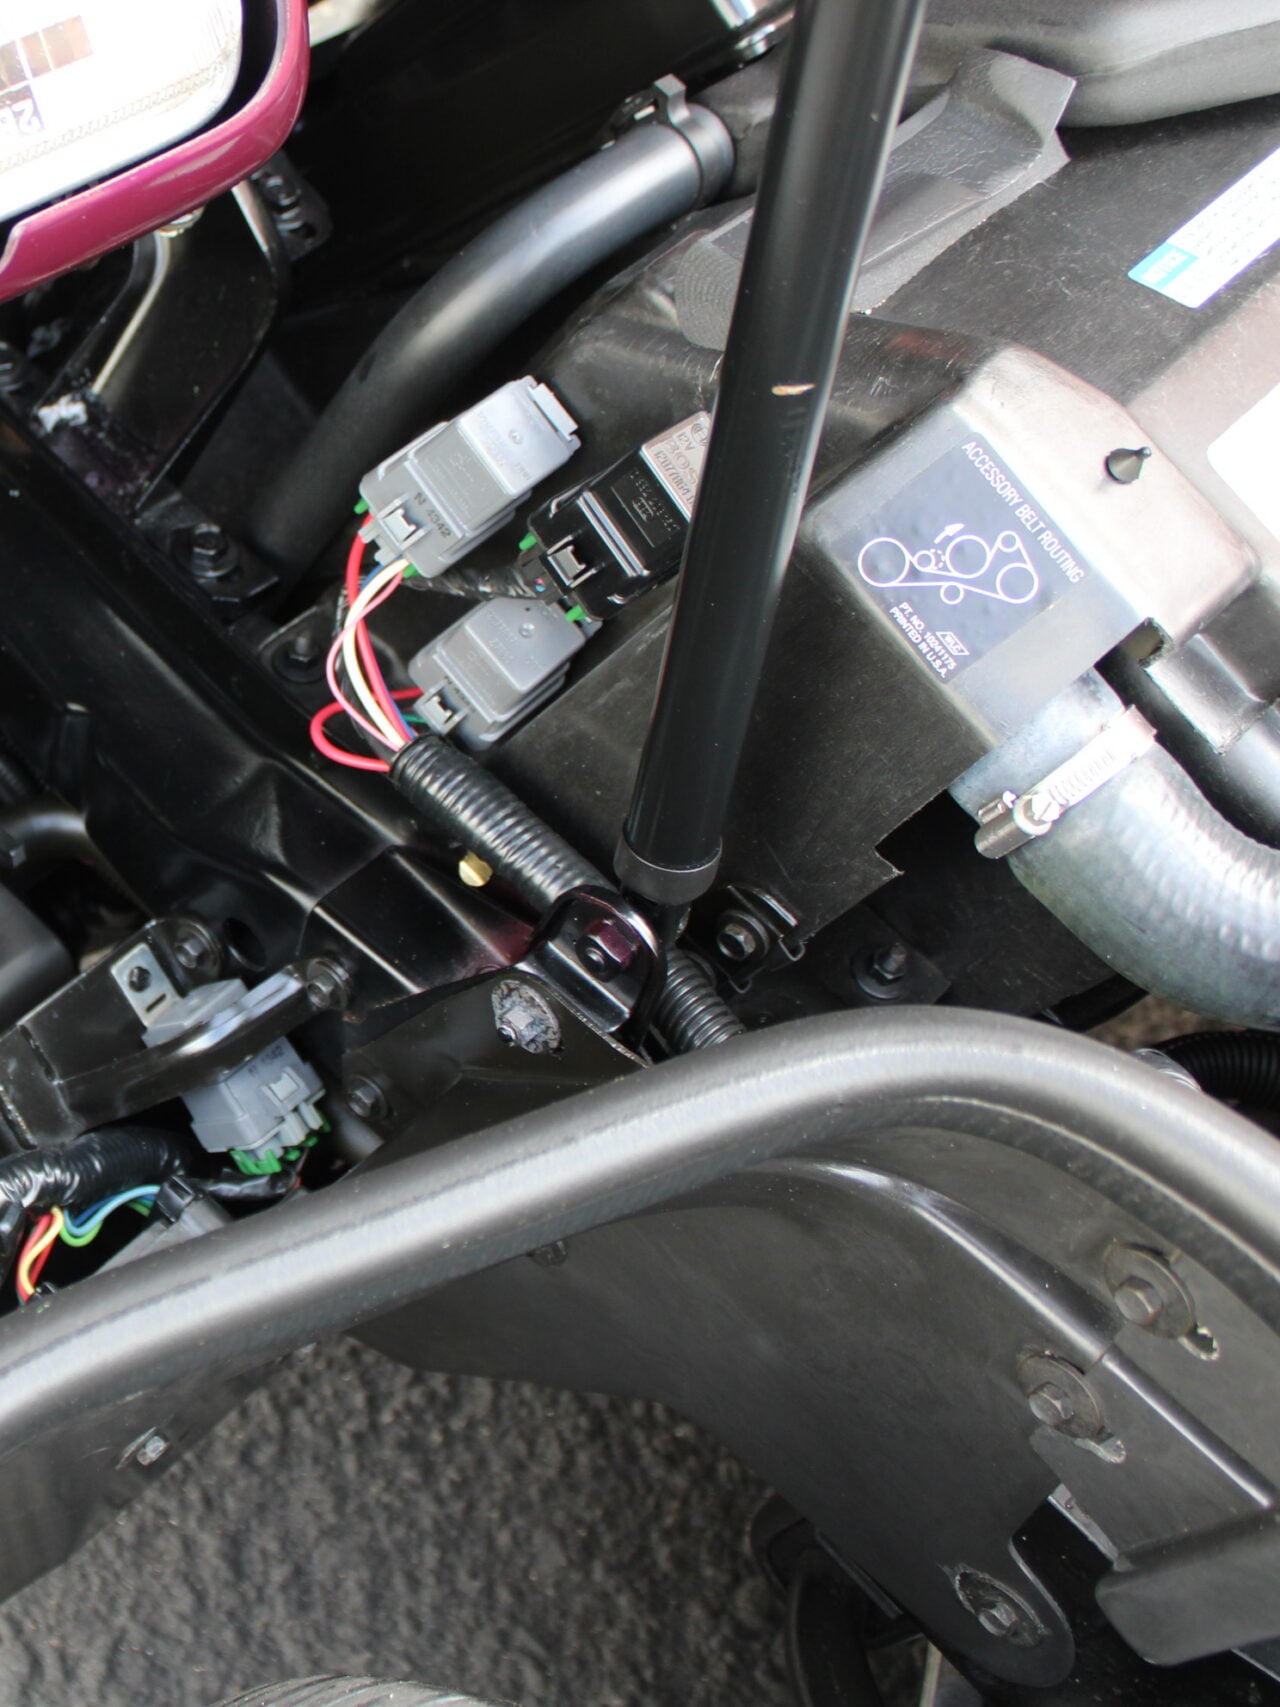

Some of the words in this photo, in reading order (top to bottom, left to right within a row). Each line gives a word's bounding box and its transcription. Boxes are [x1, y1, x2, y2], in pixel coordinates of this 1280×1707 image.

[961, 441, 1023, 506] ACCESSORY
[1014, 503, 1046, 533] BELT
[1037, 529, 1085, 583] ROUTING
[889, 606, 922, 643] PRINTED
[918, 641, 930, 654] IN
[898, 601, 914, 618] PT.
[909, 614, 925, 633] NO.
[923, 631, 958, 670] 10241175
